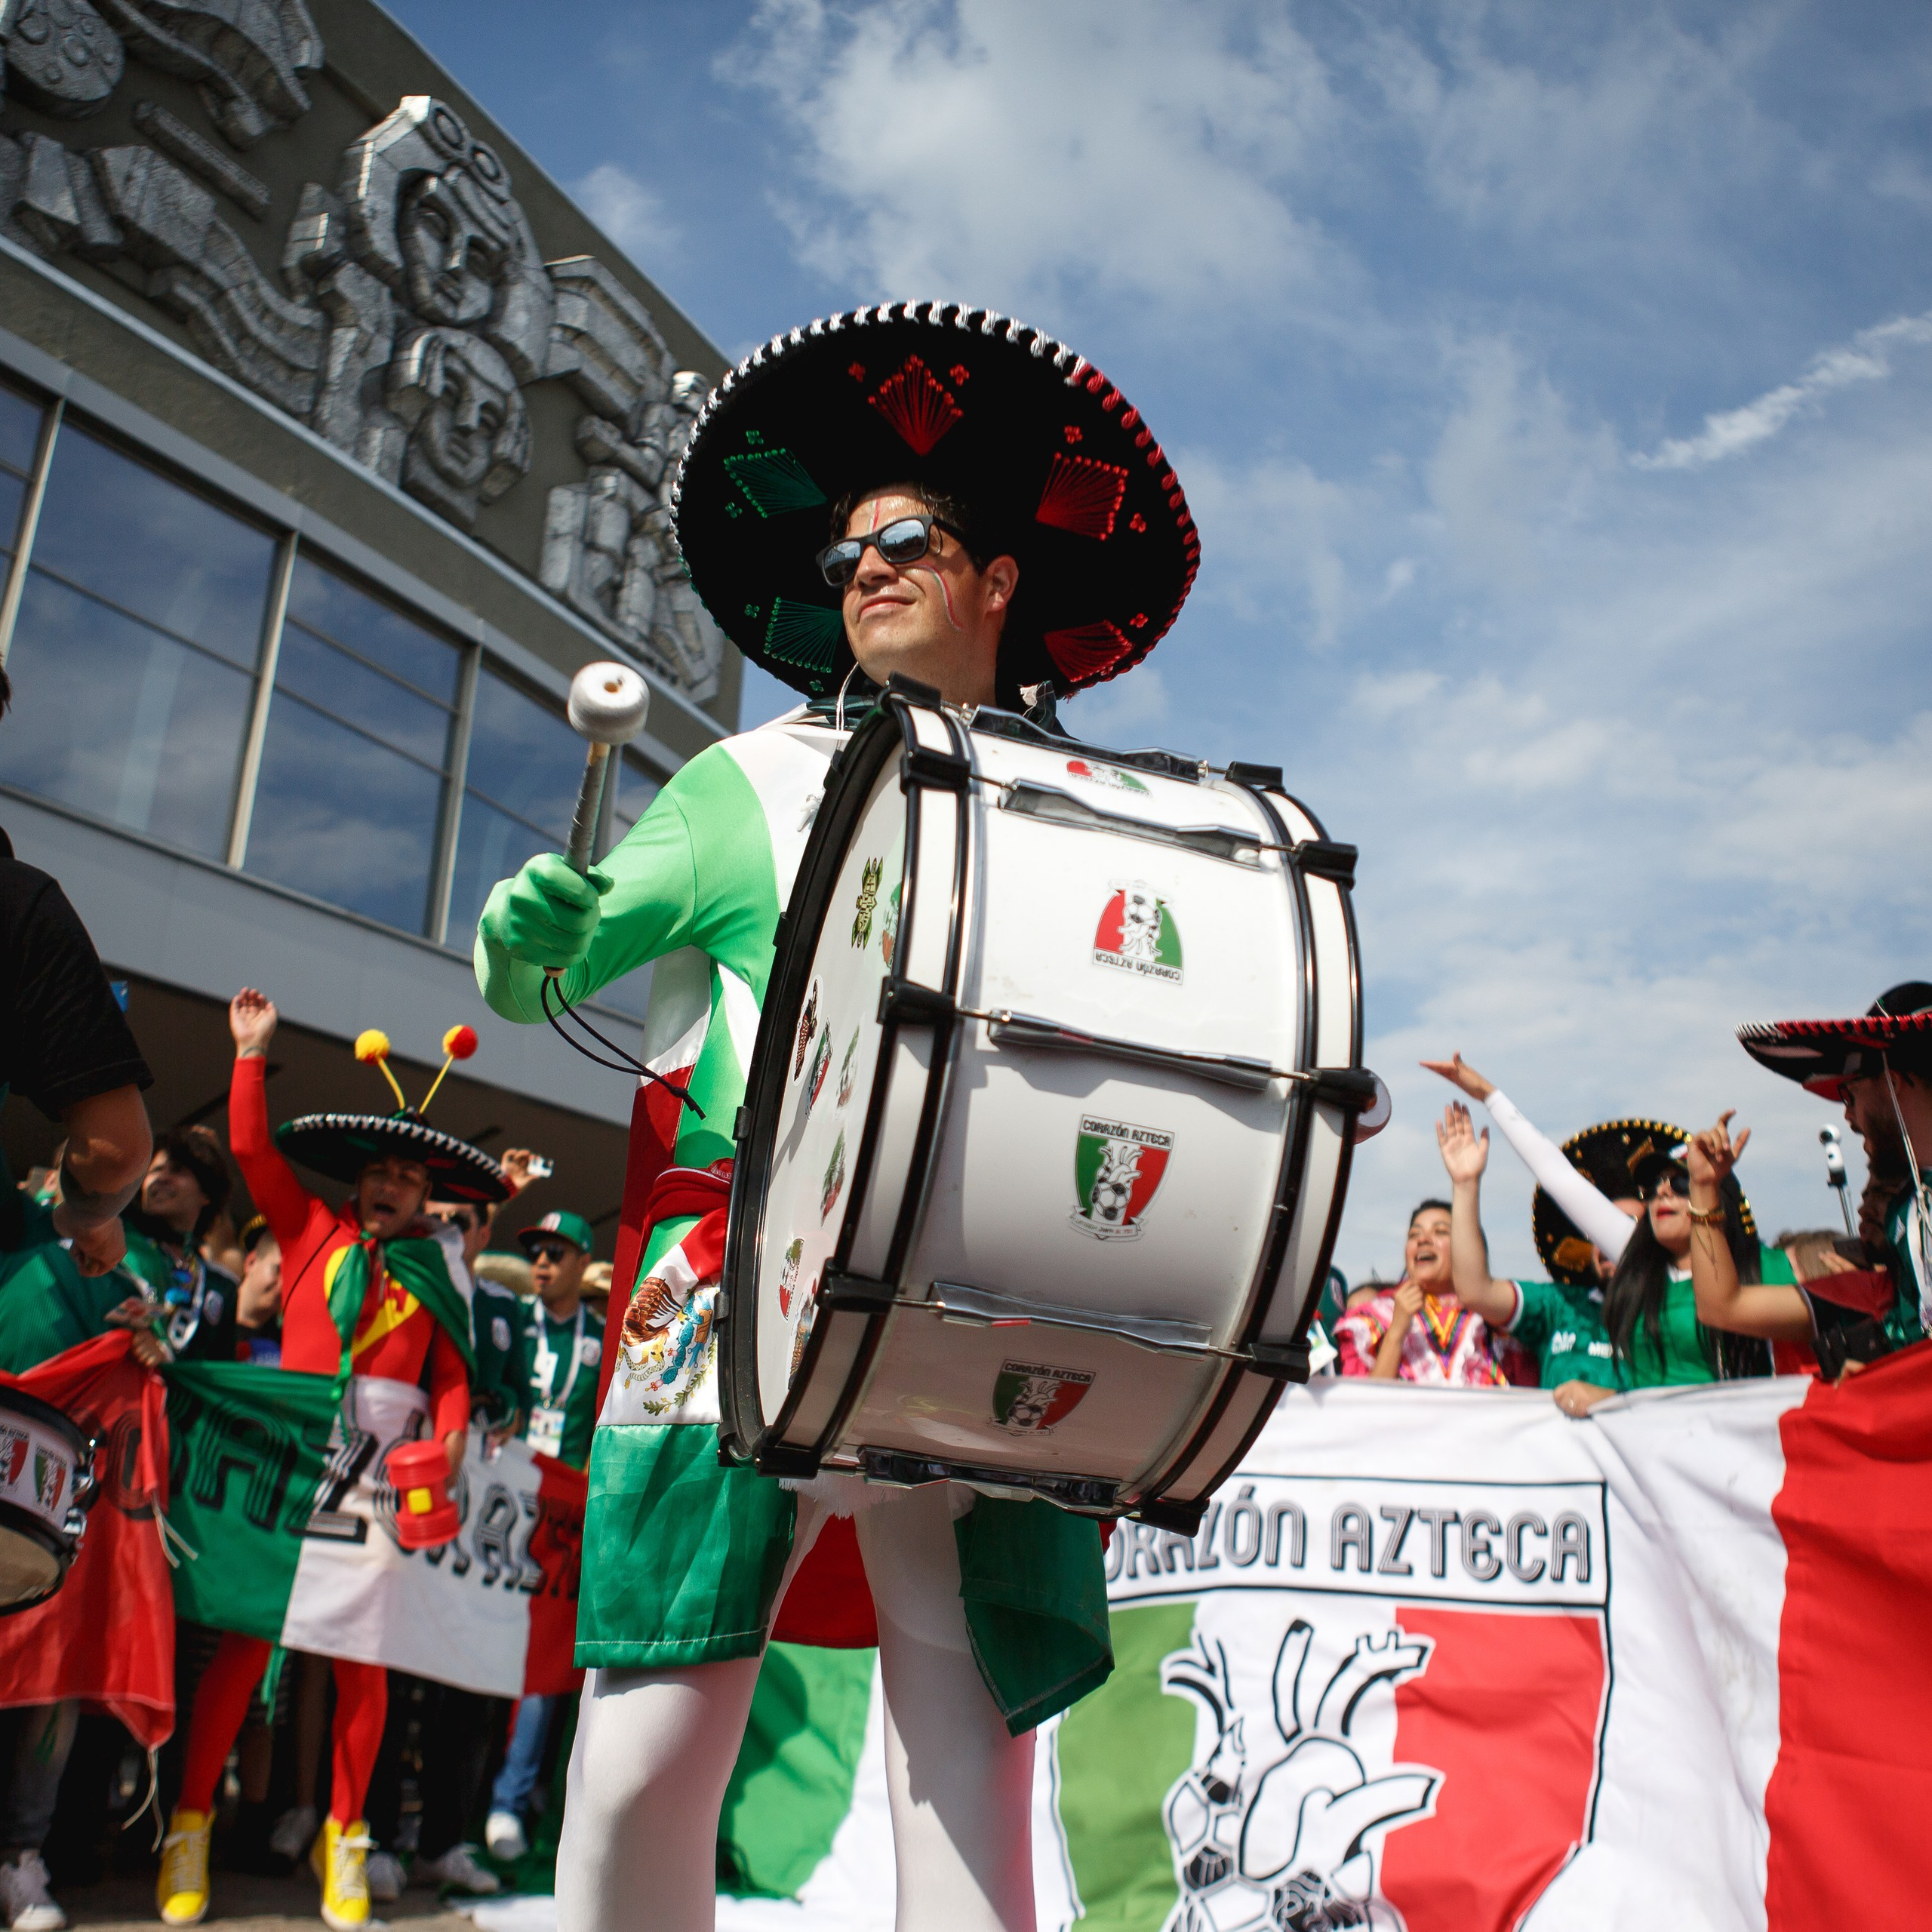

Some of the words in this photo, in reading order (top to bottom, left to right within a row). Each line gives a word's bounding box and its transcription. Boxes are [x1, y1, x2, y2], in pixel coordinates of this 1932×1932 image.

[1083, 1119, 1130, 1138] CORAZÓN
[1132, 1129, 1171, 1146] AZTECA
[1052, 1369, 1092, 1383] AZTECA
[1330, 1503, 1592, 1584] AZTECA
